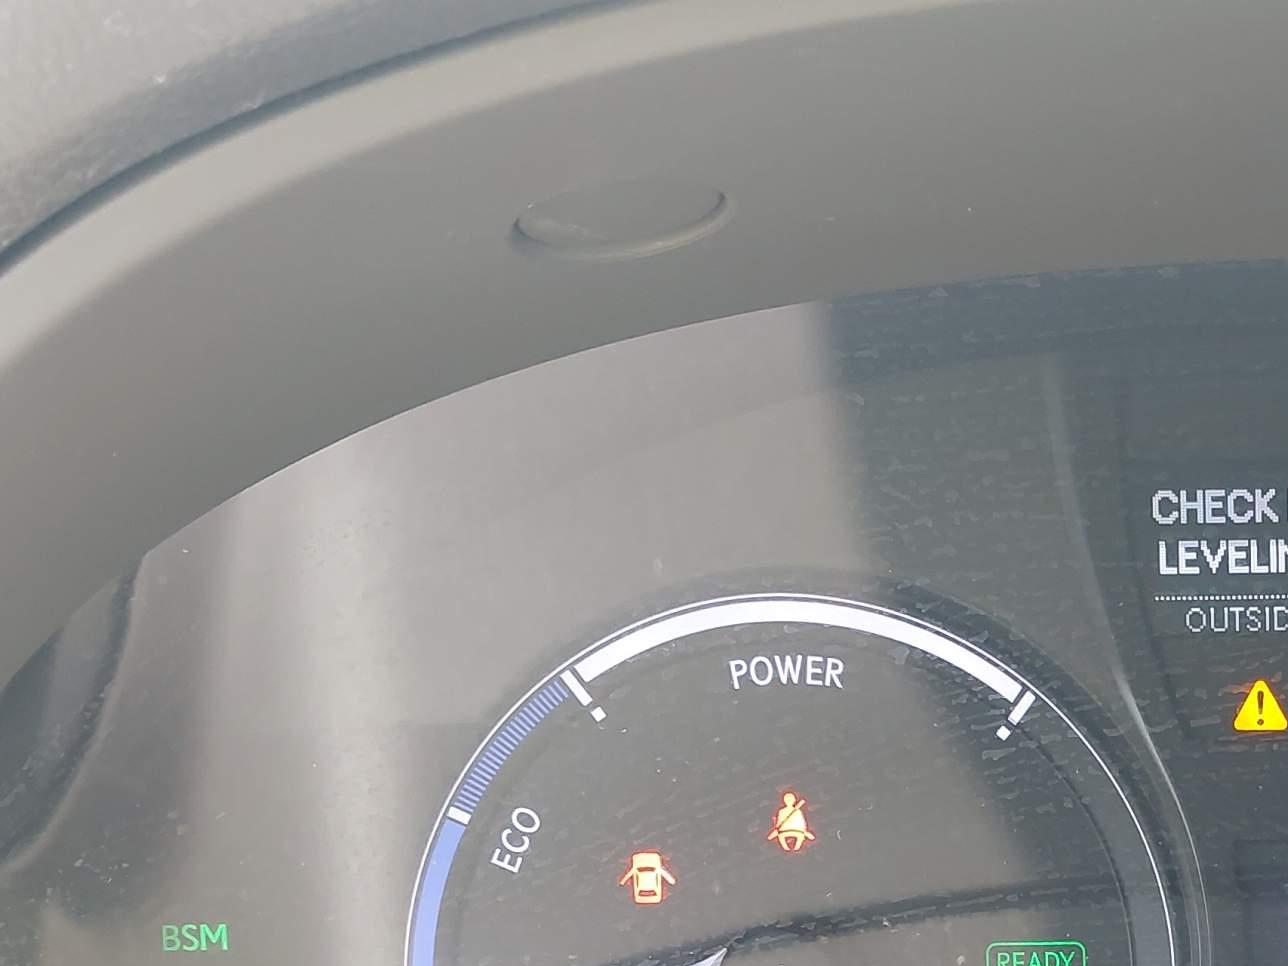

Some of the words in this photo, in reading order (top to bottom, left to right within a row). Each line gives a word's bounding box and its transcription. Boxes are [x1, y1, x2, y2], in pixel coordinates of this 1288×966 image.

[1151, 488, 1279, 525] CHECK
[728, 654, 844, 690] POWER
[489, 806, 542, 874] ECO
[161, 923, 230, 952] BSM
